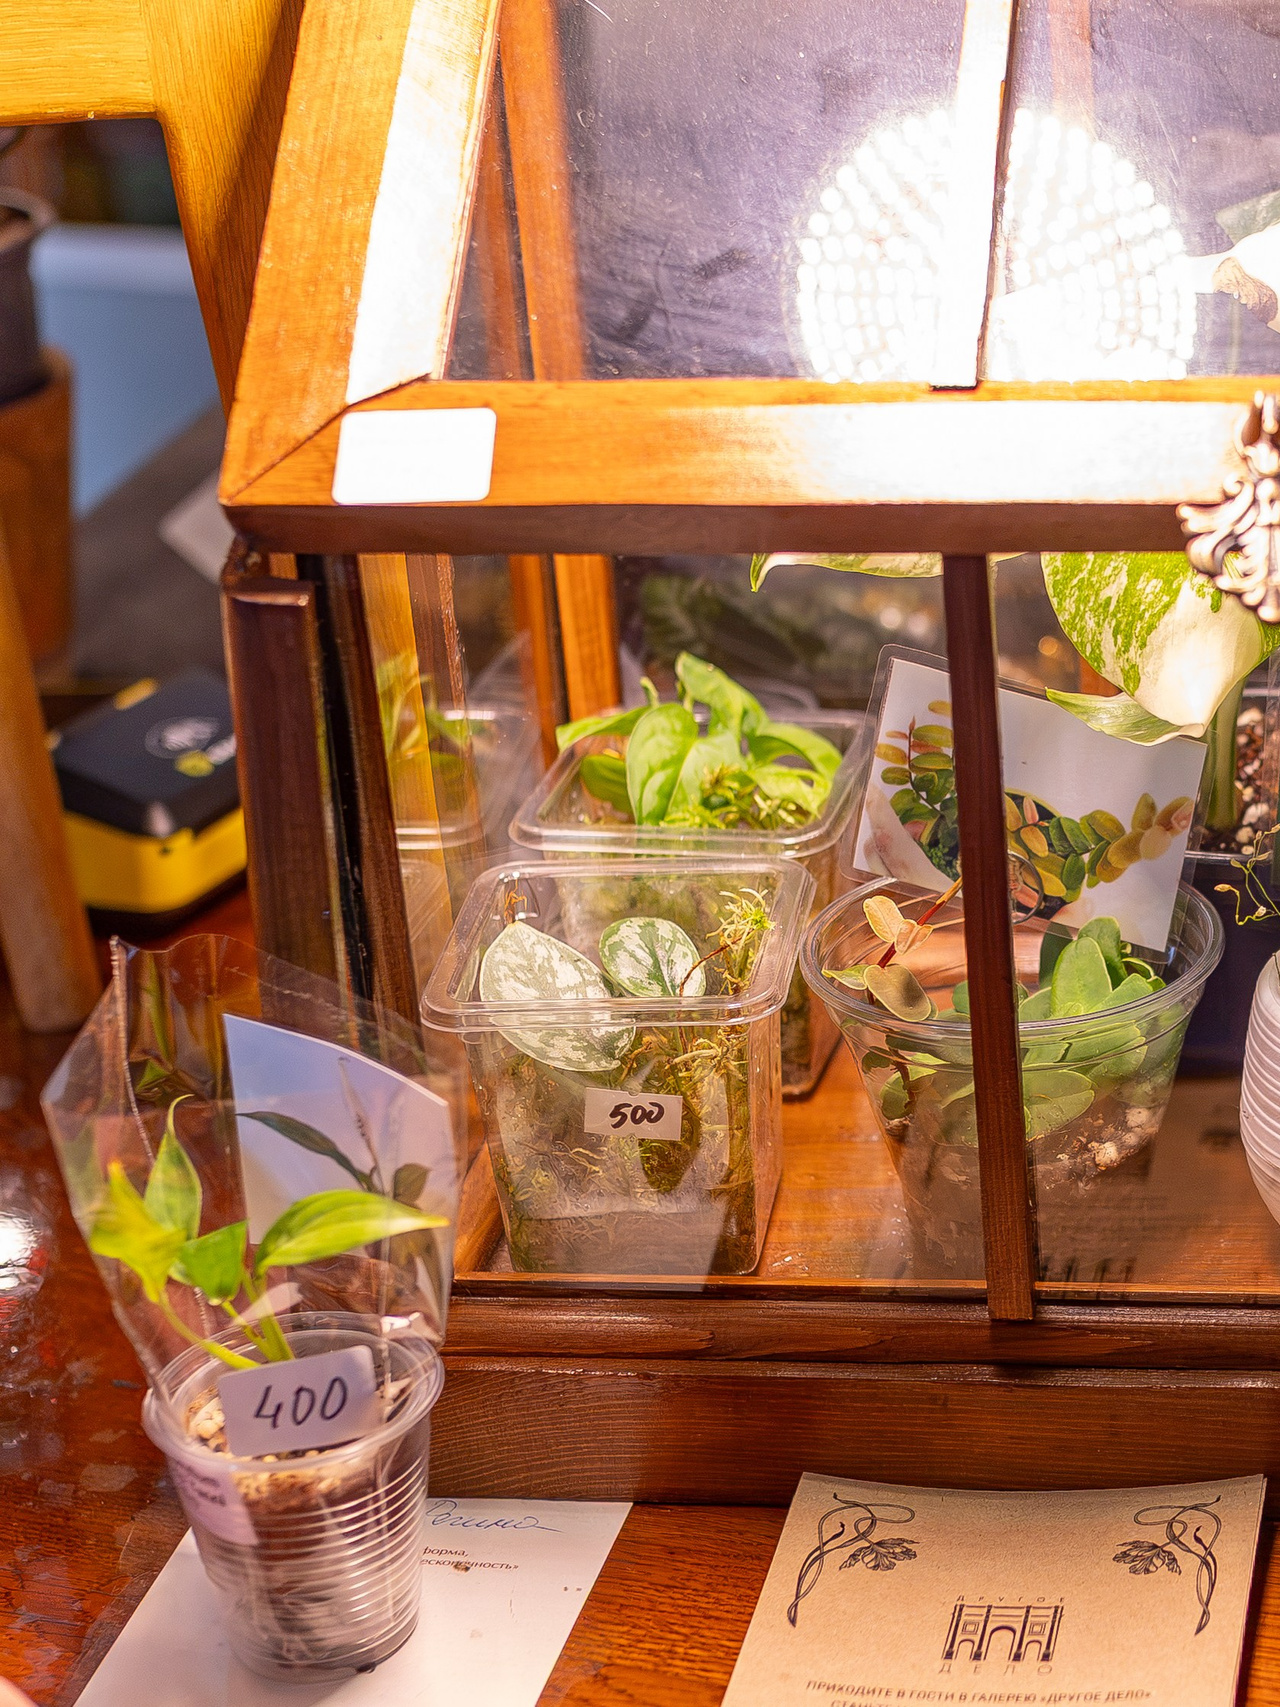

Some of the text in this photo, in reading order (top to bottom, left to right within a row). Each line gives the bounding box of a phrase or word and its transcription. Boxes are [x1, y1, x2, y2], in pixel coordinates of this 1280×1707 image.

[609, 1101, 665, 1129] 500
[254, 1376, 347, 1429] 400
[938, 1663, 1053, 1676] ДЕЛО
[806, 1680, 893, 1698] ПРИХОДИТЕ
[909, 1690, 955, 1702] ГОСТИ
[958, 1692, 968, 1702] В
[972, 1692, 1037, 1704] ГАЛЕРЕЮ
